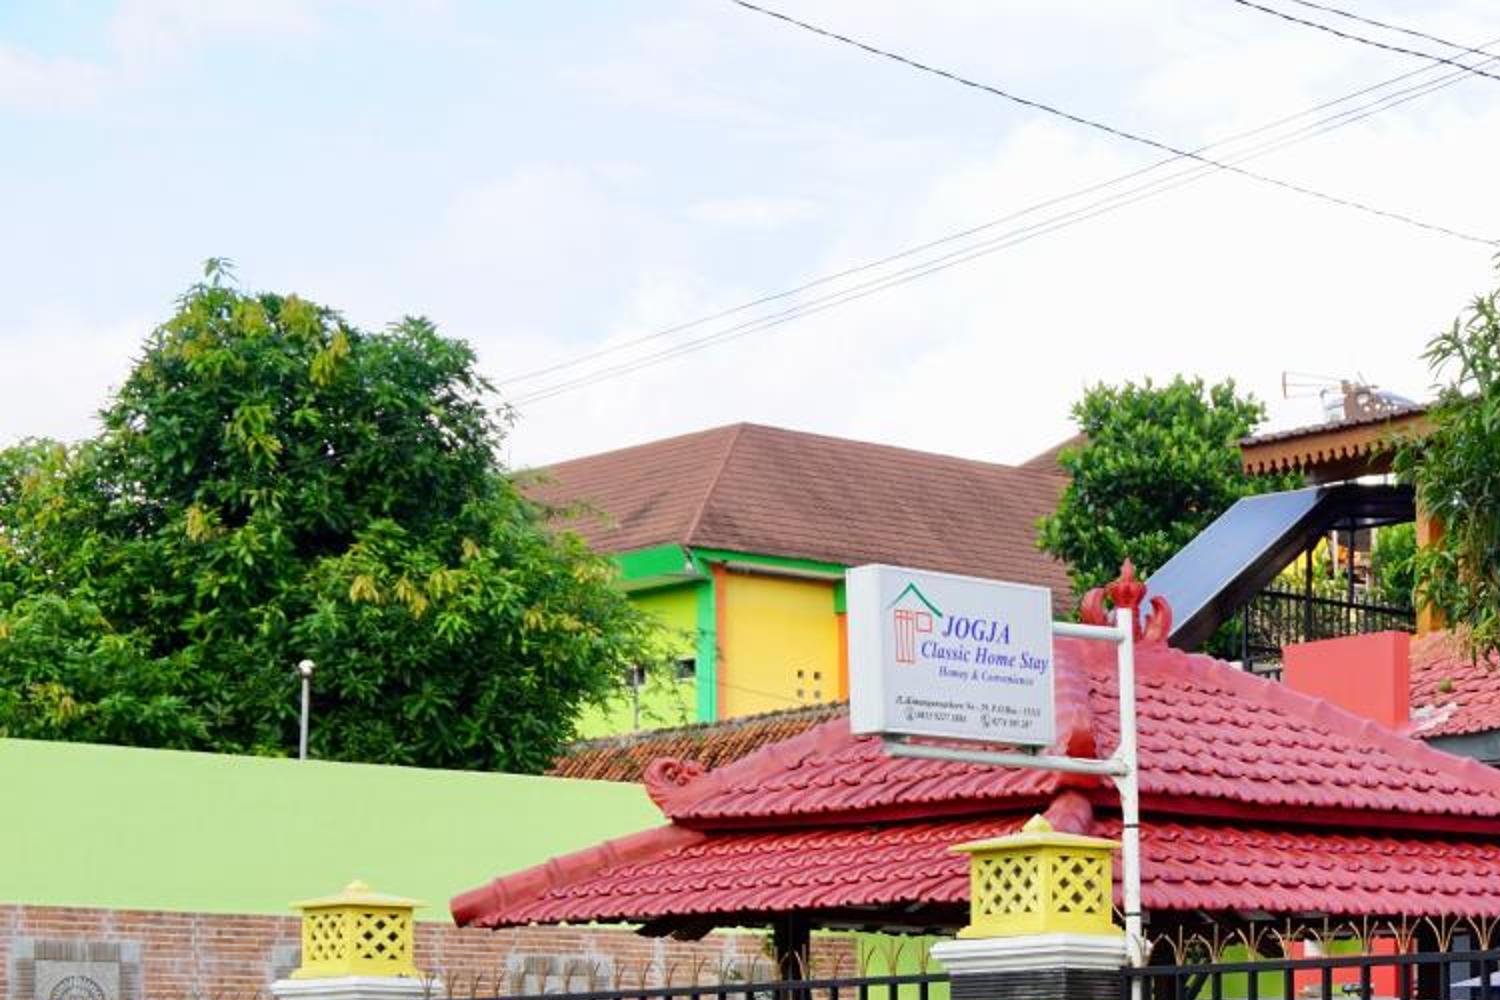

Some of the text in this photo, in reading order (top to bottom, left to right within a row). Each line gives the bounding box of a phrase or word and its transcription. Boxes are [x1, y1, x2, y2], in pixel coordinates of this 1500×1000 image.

[942, 615, 1010, 645] JOGJA
[921, 639, 1049, 675] Classic Home Stay
